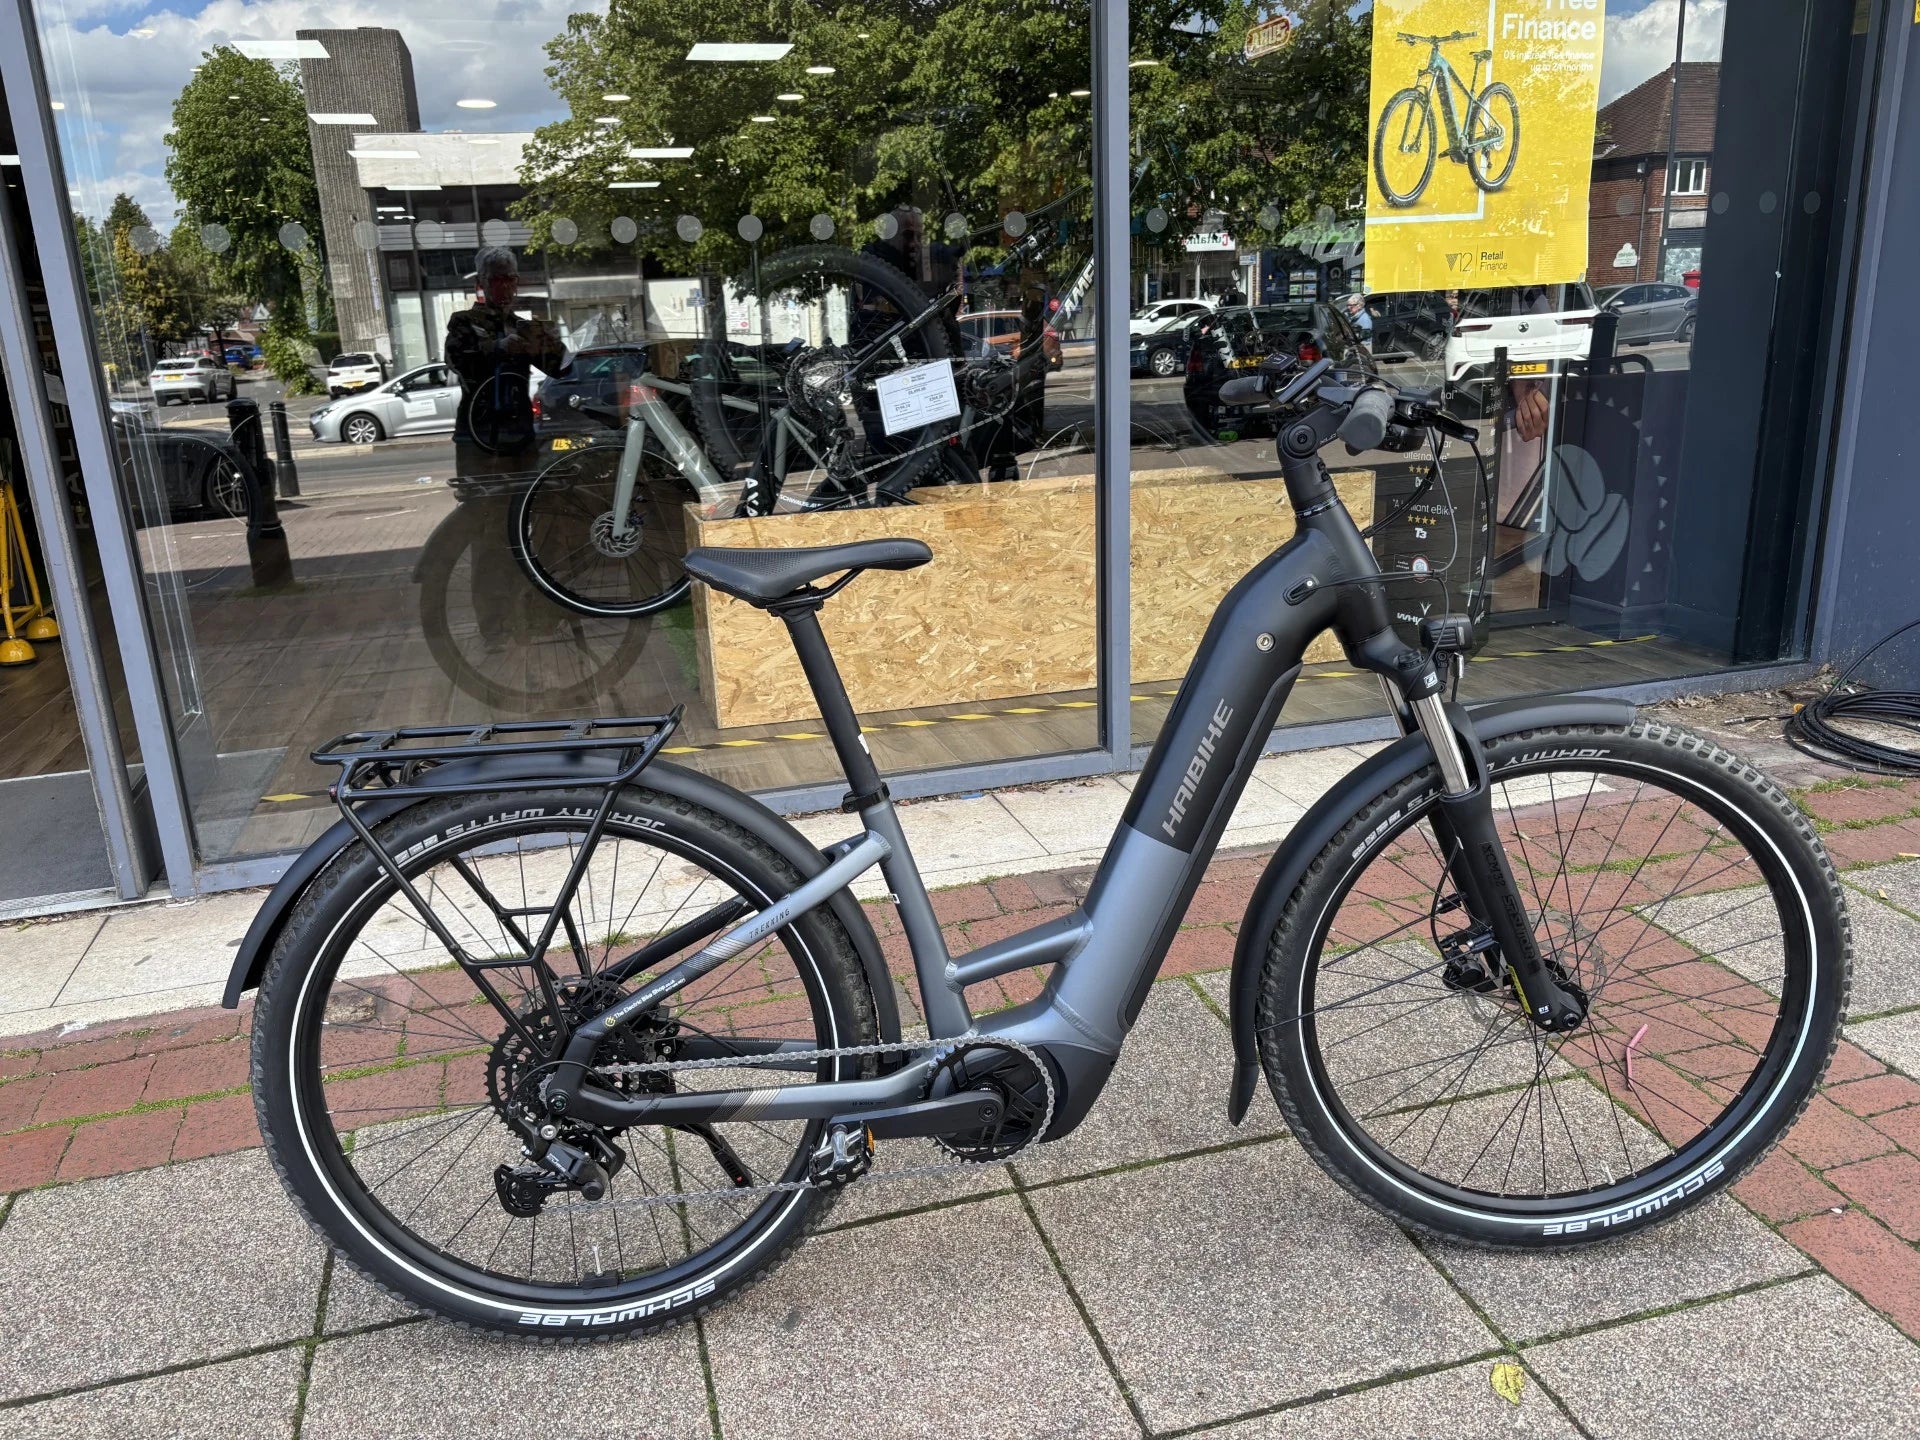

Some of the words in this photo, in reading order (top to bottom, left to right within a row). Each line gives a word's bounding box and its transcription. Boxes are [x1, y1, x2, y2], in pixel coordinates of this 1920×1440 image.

[1502, 13, 1596, 40] Finance
[1480, 262, 1508, 271] Finance
[1481, 251, 1504, 260] Retail
[1414, 527, 1428, 539] T3
[1161, 698, 1234, 838] HAIBIKE
[1504, 749, 1611, 767] JOHNNY
[445, 808, 545, 838] WATTS
[749, 908, 790, 939] TREKKING
[613, 1010, 625, 1019] The
[623, 999, 643, 1014] Electric
[1543, 1160, 1725, 1236] SCHWALBE
[518, 1279, 715, 1326] SCHWALBE
